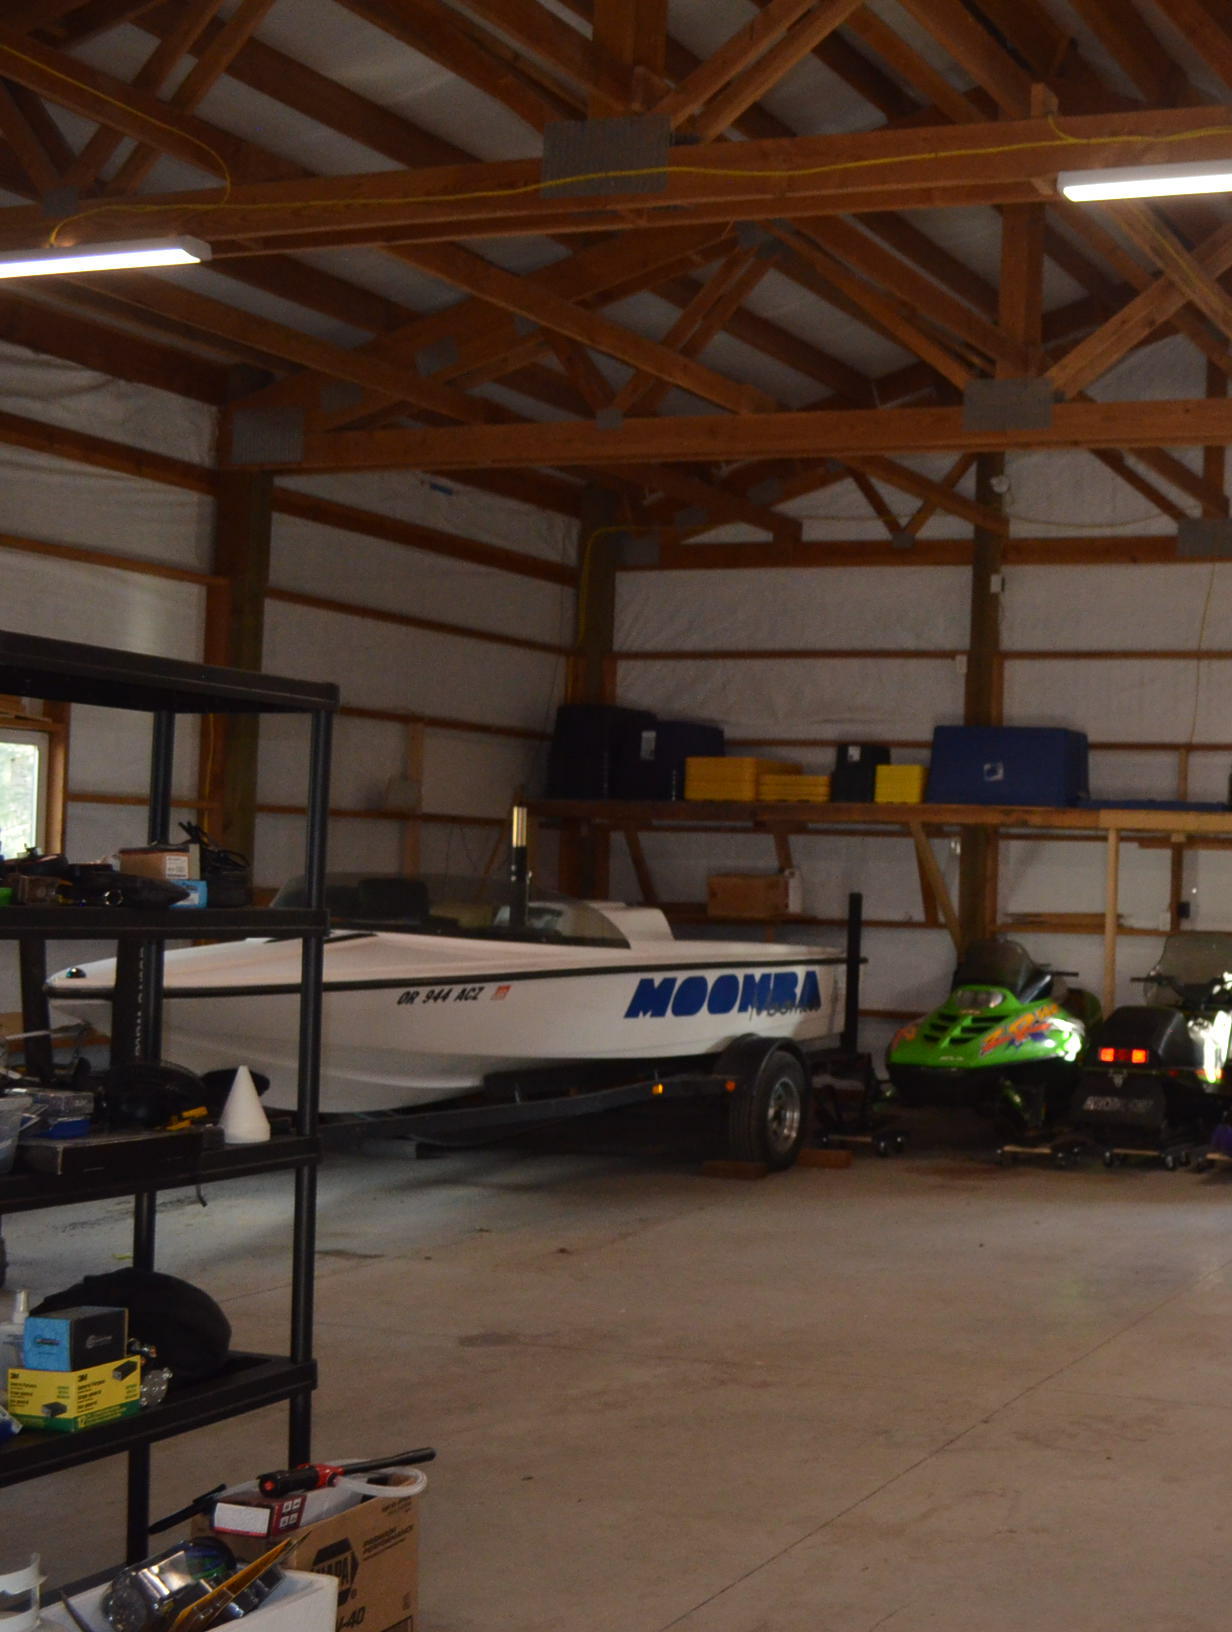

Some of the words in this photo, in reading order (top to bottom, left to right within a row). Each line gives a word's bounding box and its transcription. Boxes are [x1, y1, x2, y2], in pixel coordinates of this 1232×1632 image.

[397, 991, 420, 1005] OR
[422, 988, 453, 1004] 944
[624, 970, 822, 1019] MOOMBA
